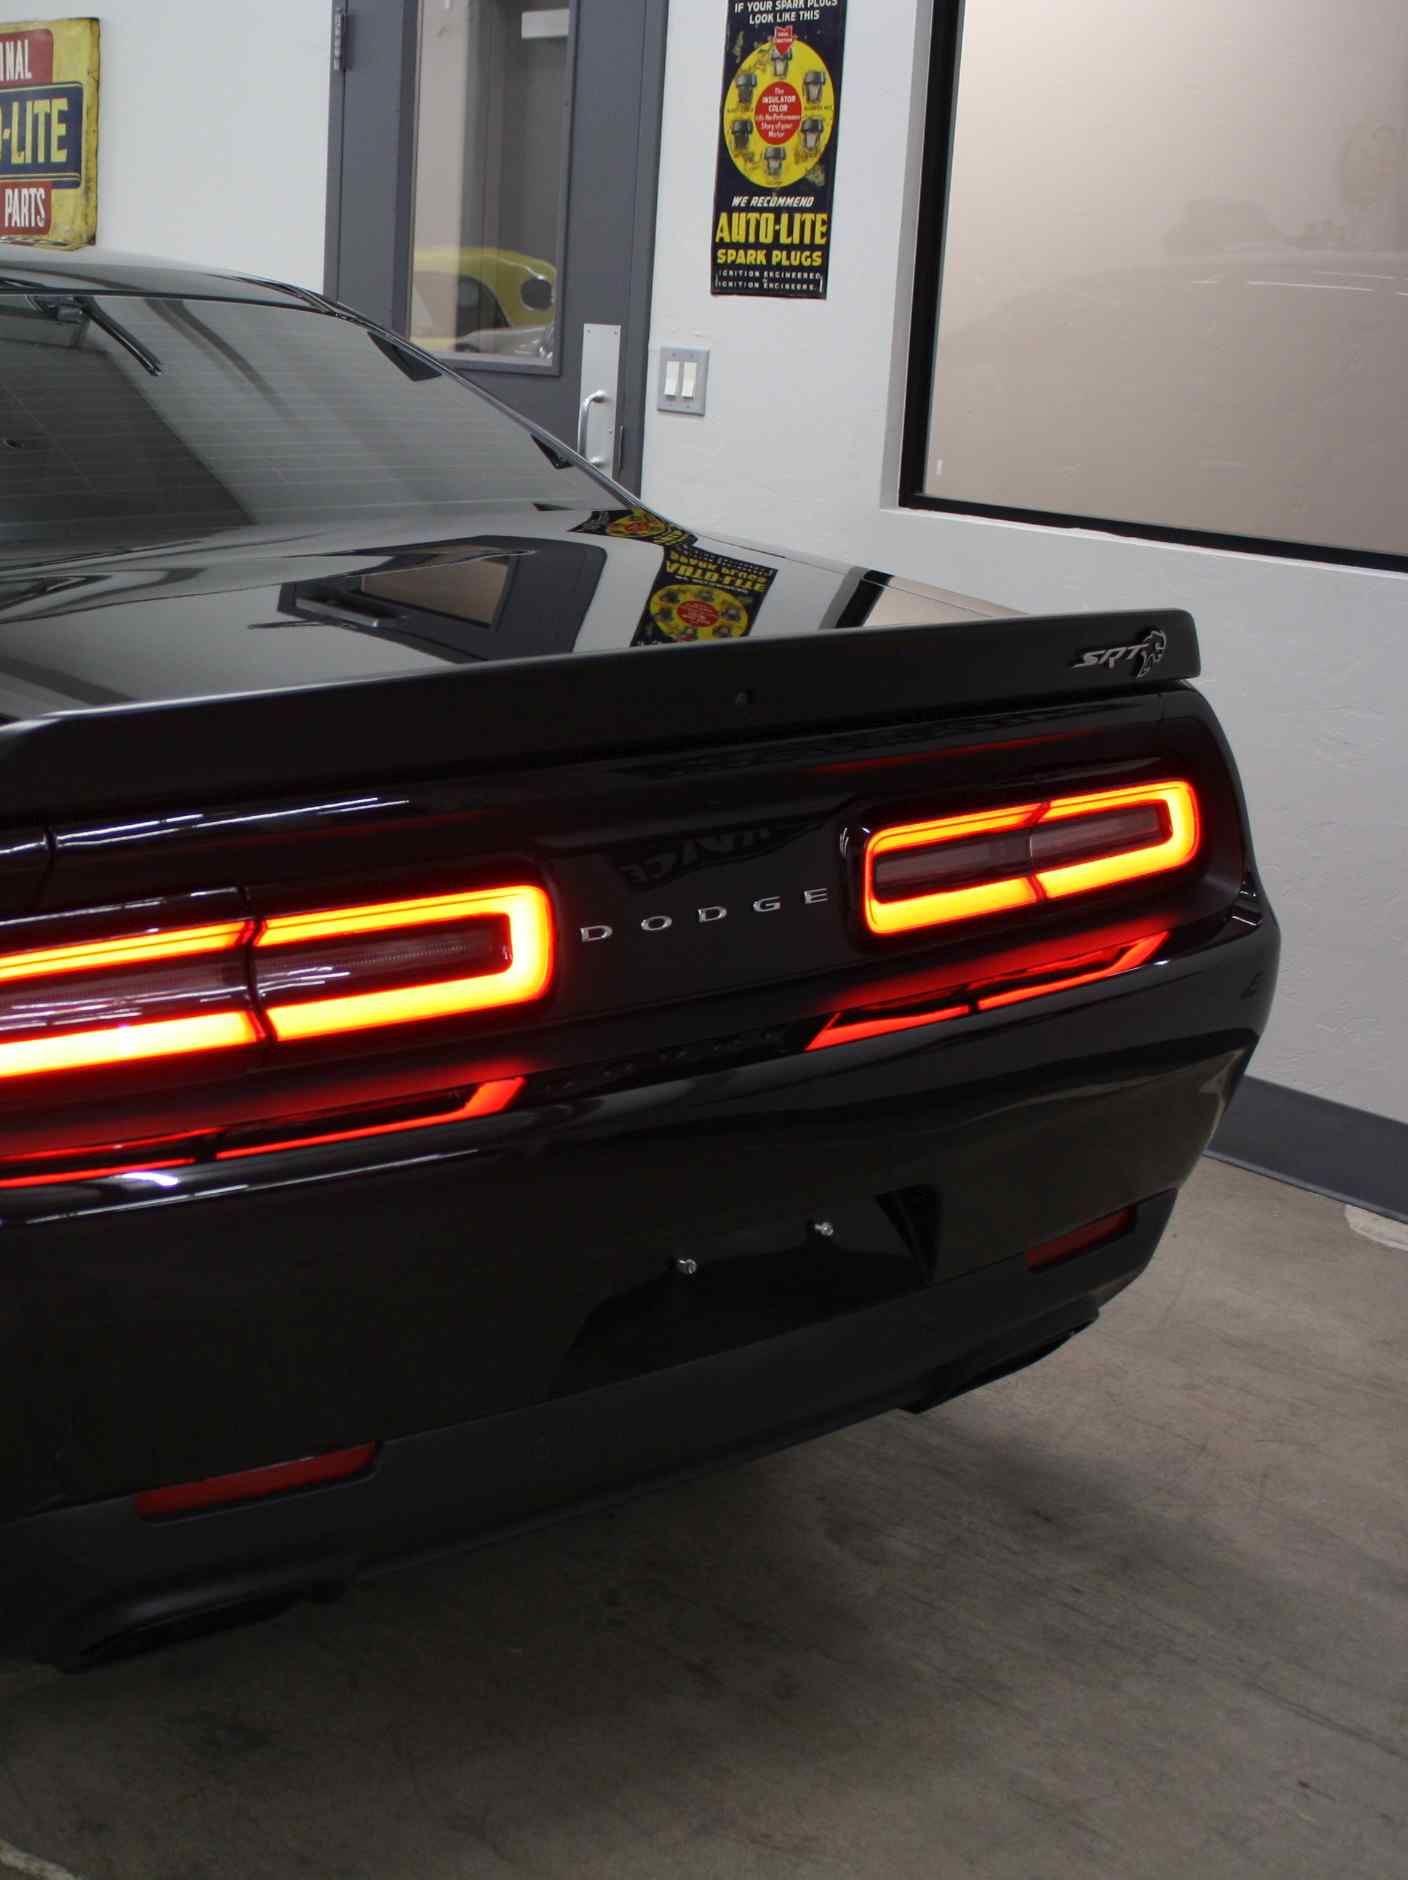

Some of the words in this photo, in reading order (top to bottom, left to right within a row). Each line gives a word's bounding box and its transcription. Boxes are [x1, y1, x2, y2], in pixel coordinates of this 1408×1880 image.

[734, 3, 744, 13] IF
[747, 1, 773, 12] YOUR
[775, 0, 805, 10] SPARK
[749, 14, 774, 24] LOOK
[776, 12, 797, 22] LIKE
[799, 10, 820, 20] THIS
[762, 95, 796, 103] INSULATOR
[768, 104, 788, 112] COLOR
[5, 188, 45, 227] PARTS
[732, 196, 749, 207] WE
[750, 196, 814, 207] RECOMMEND
[715, 212, 828, 245] AUTO-LITE
[717, 249, 766, 265] SPARK
[772, 250, 822, 266] PLUGS
[1072, 643, 1150, 669] SRT
[580, 888, 828, 942] DODGE
